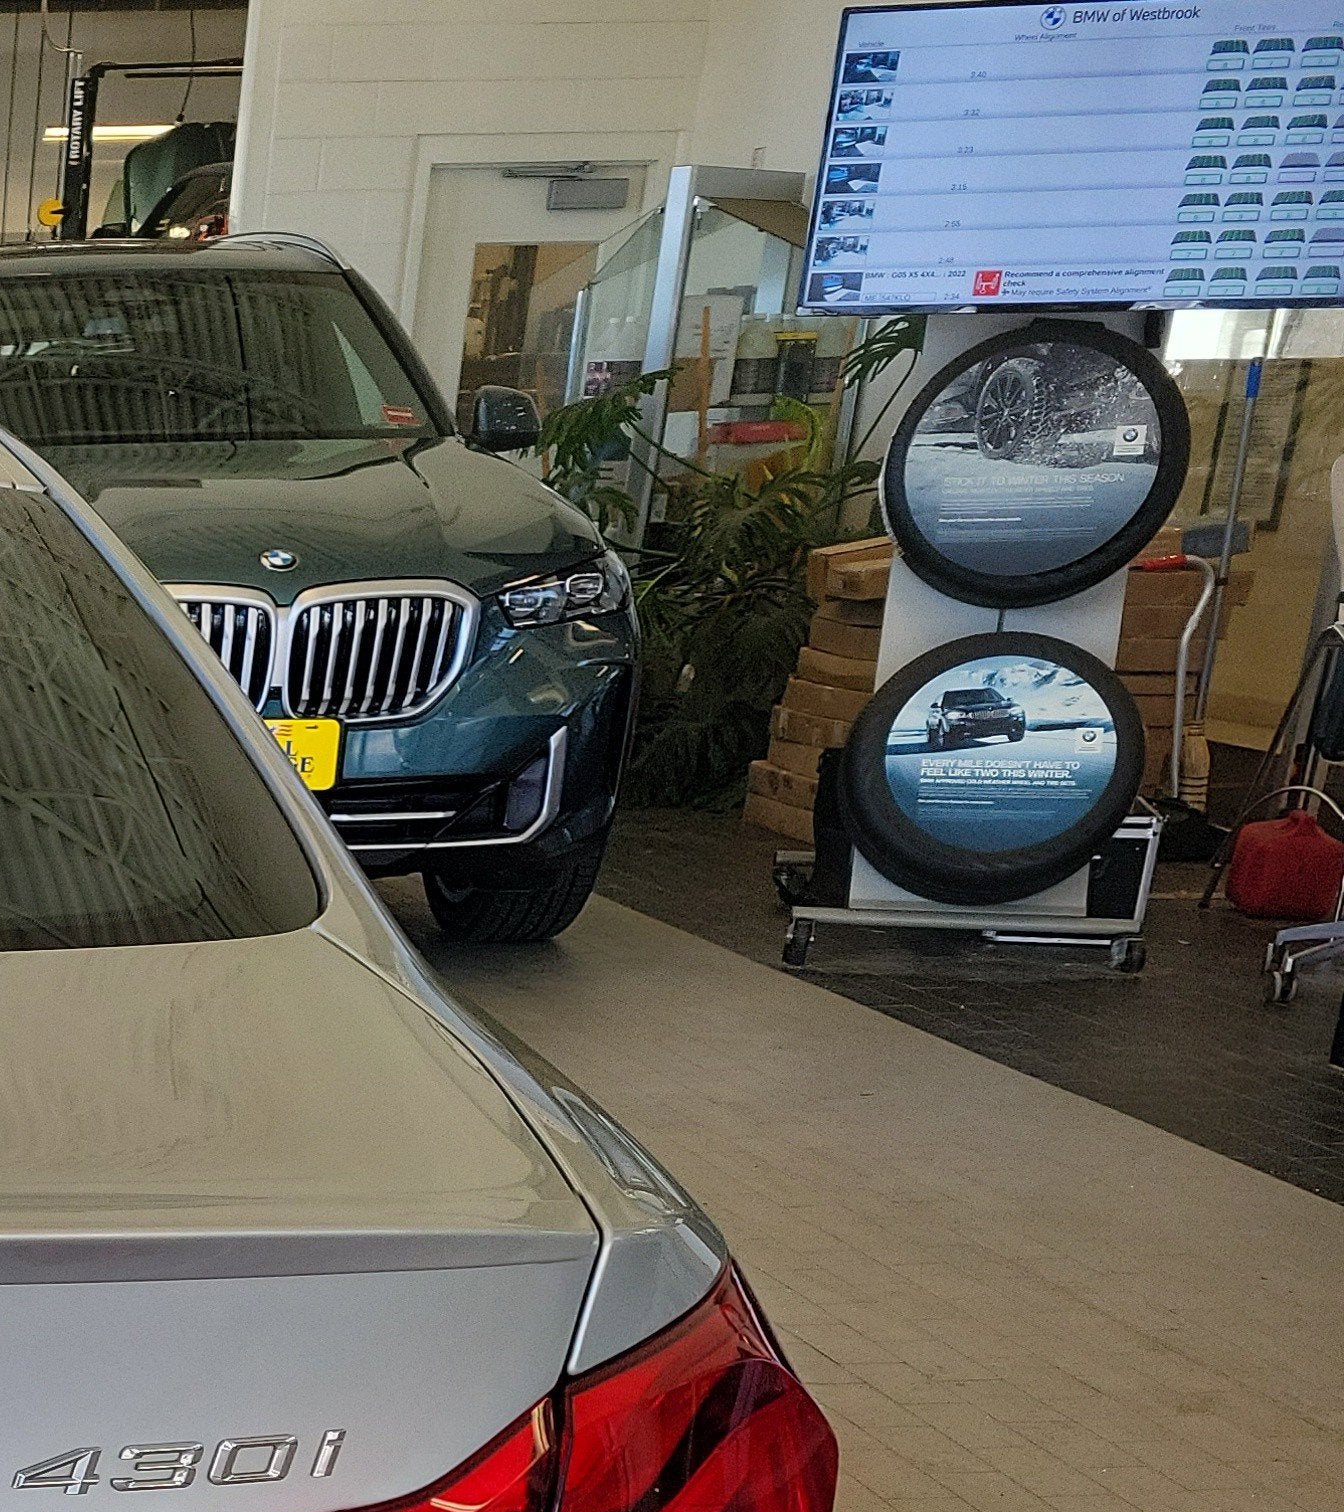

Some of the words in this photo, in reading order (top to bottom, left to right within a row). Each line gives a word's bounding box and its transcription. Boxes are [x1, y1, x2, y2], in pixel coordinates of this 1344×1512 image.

[1072, 10, 1110, 24] BMW
[1113, 9, 1127, 22] of
[1129, 6, 1202, 21] Westbrook
[74, 81, 84, 106] LIFT
[69, 110, 82, 159] ROTARY
[1004, 270, 1054, 278] Recommend
[1062, 269, 1124, 280] comprehensive
[1124, 267, 1166, 278] alignment
[1002, 279, 1026, 287] check
[1011, 289, 1027, 298] May
[1028, 289, 1054, 298] require
[1056, 287, 1079, 297] Safety
[1081, 287, 1110, 297] System
[990, 475, 1006, 486] TO
[1053, 474, 1077, 484] THIS
[1079, 472, 1125, 483] SEASON
[921, 758, 956, 768] EVERY
[957, 758, 983, 769] MILE
[985, 759, 1032, 769] DOESN'T
[1033, 760, 1063, 770] HAVE
[1063, 760, 1081, 770] TO
[920, 768, 948, 777] FEEL
[948, 768, 972, 778] LIKE
[974, 768, 1000, 778] TWO
[1001, 769, 1026, 778] THIS
[12, 1428, 348, 1496] 430i
